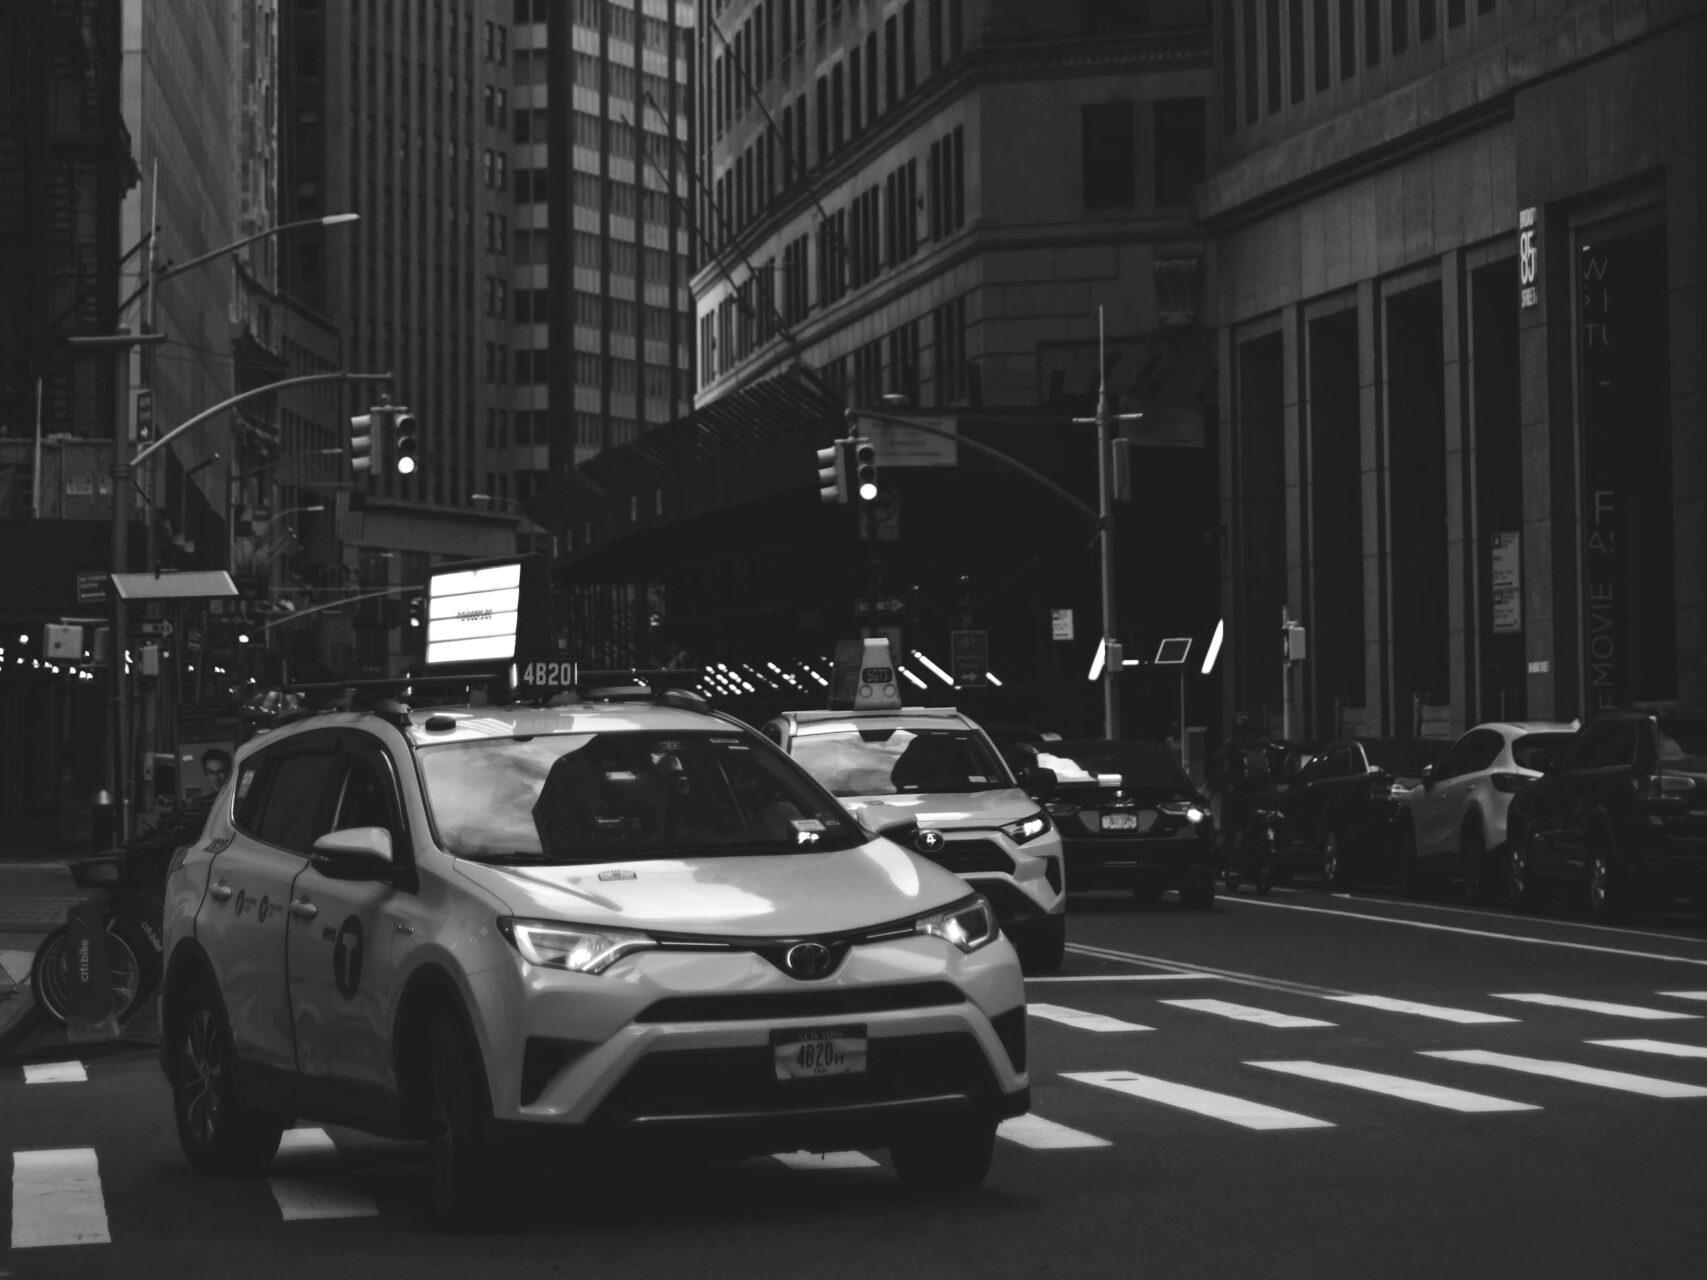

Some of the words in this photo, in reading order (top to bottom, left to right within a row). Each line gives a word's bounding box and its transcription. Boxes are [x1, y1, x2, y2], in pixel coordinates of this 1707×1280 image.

[1520, 229, 1537, 285] 85
[1589, 581, 1615, 687] MOVIE
[523, 661, 571, 686] 4B20
